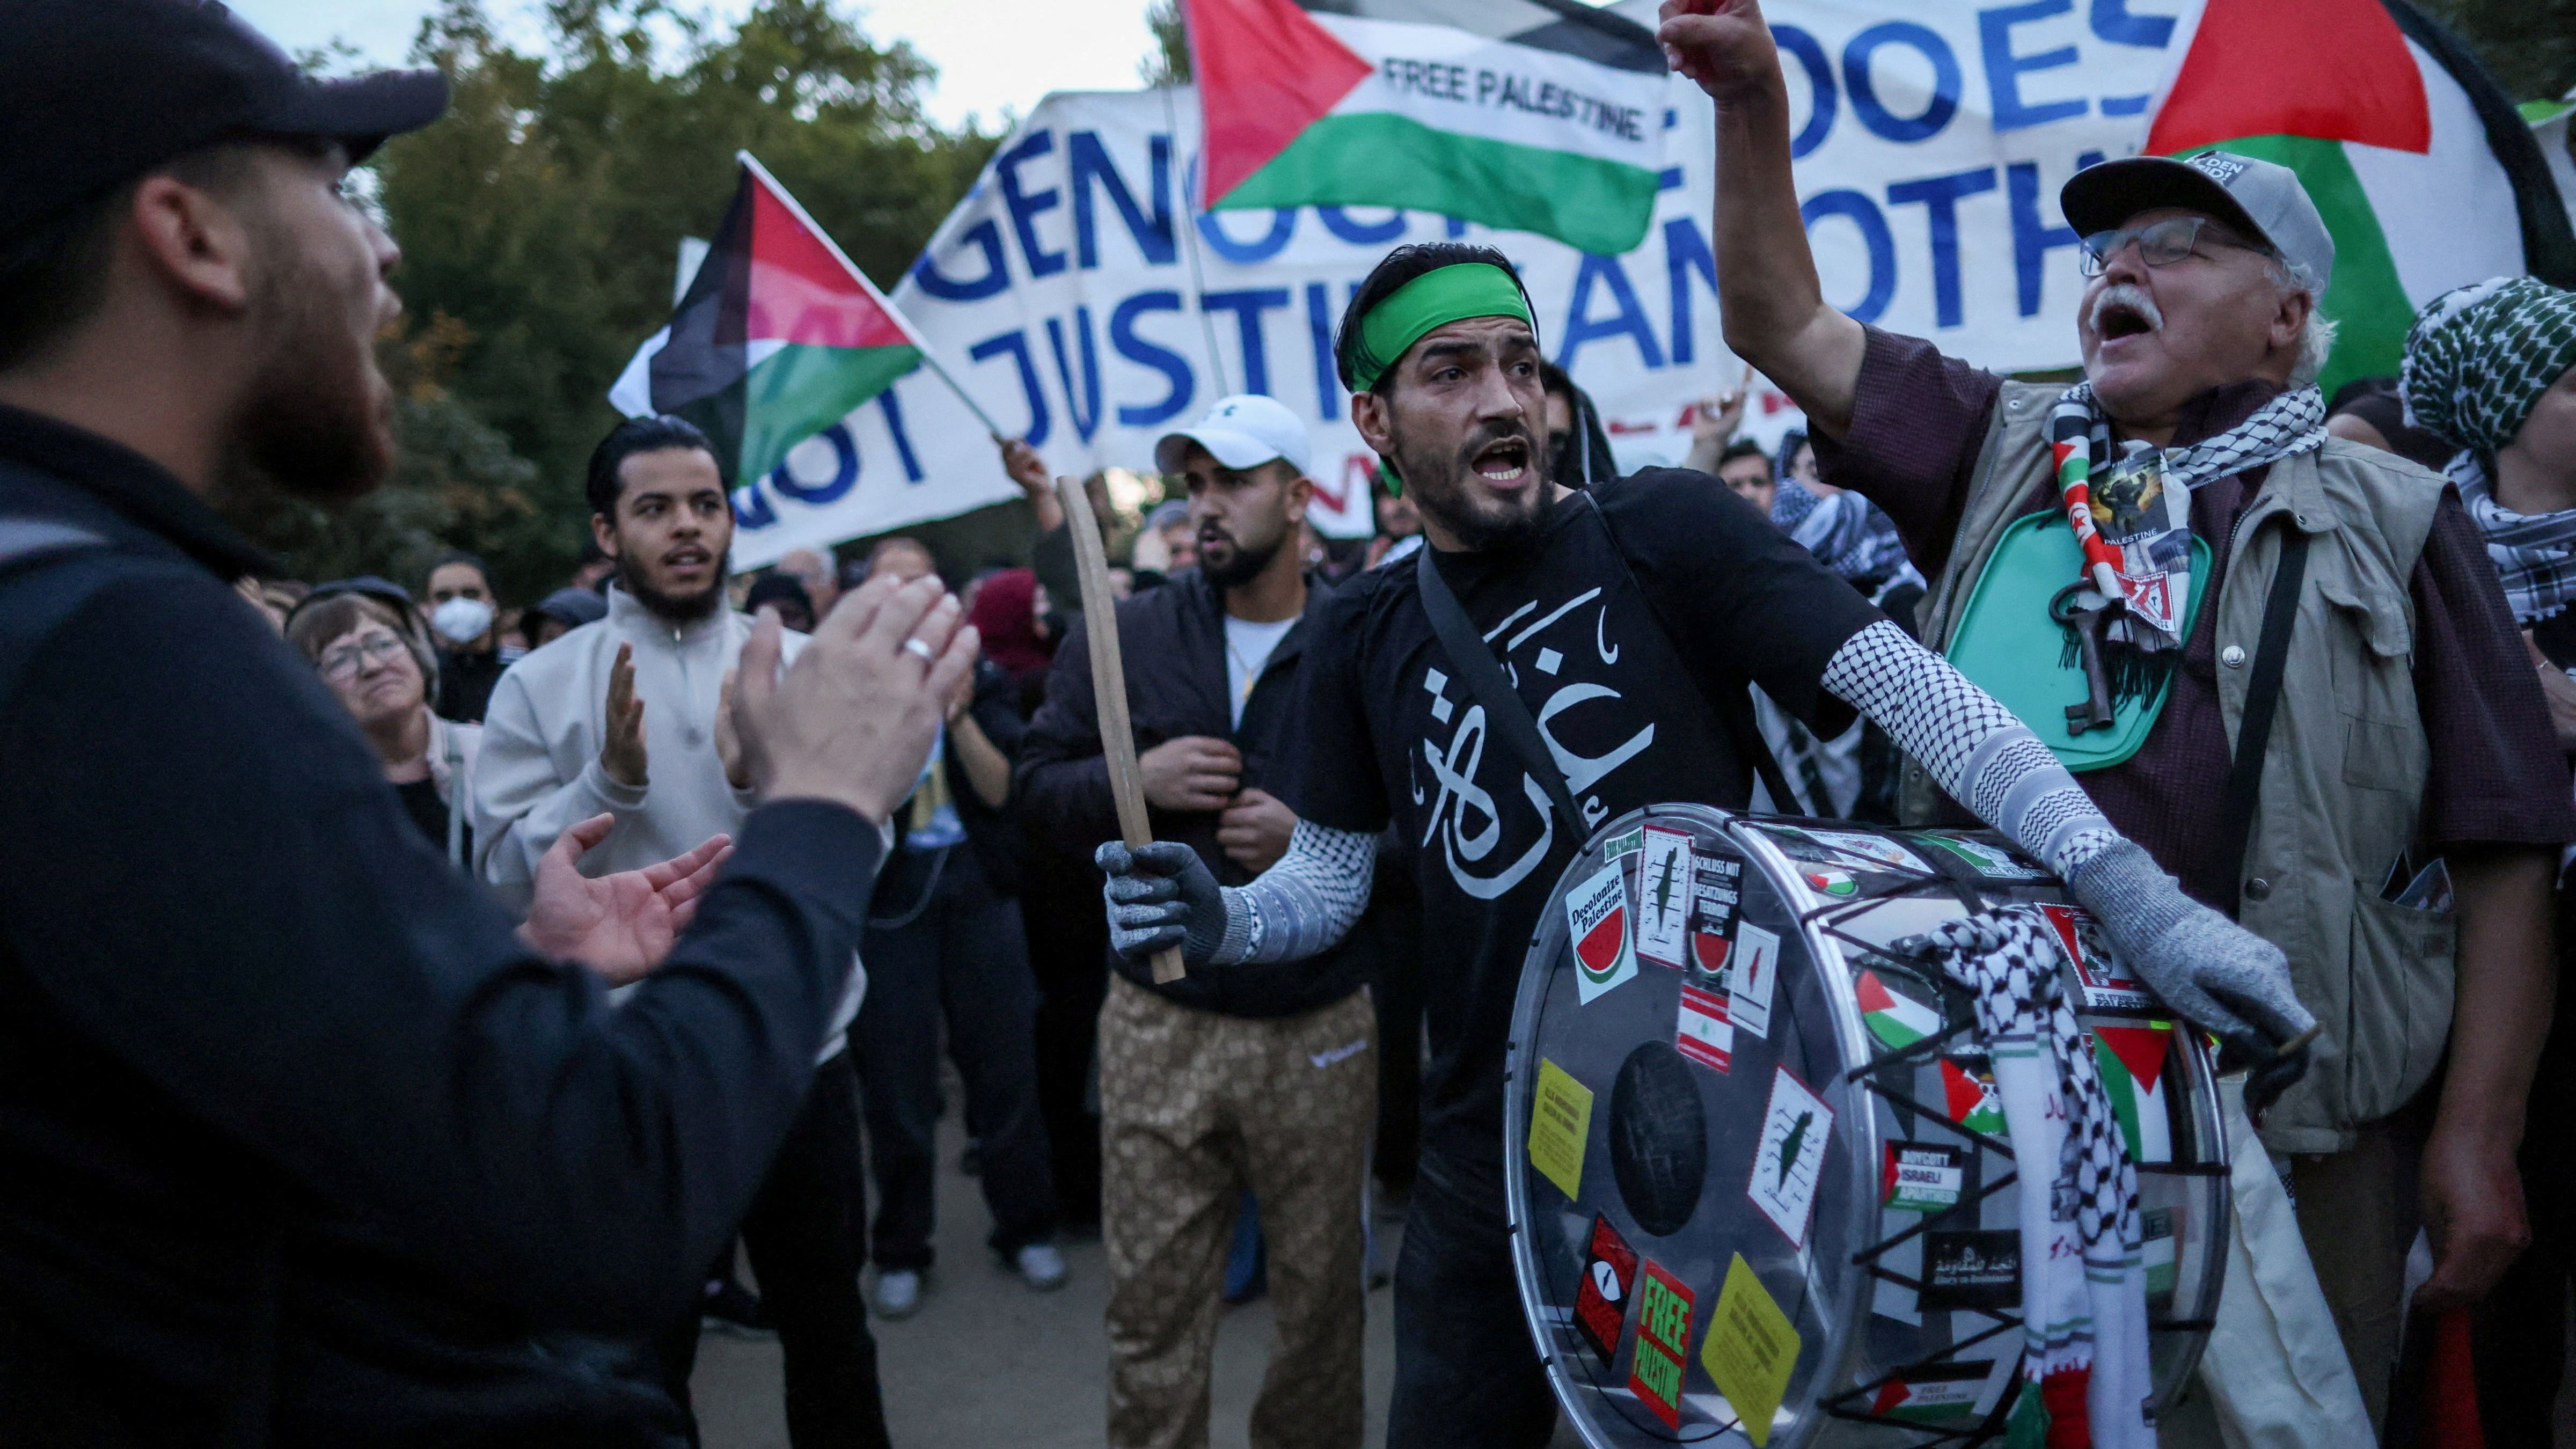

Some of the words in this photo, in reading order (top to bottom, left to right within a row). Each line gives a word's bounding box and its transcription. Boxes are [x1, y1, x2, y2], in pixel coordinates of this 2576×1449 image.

[1384, 56, 1468, 103] FREE
[1475, 68, 1647, 142] PALESTINE
[2206, 158, 2244, 173] DEN
[968, 264, 1522, 450] JUSTI
[1550, 150, 2106, 370] ANOTH
[2112, 455, 2135, 469] FREE
[2104, 528, 2158, 546] PALESTINE
[1695, 855, 1725, 874] SCHLUSS
[1725, 861, 1740, 877] MIT
[1572, 874, 1620, 927] Decolonize
[1581, 889, 1623, 934] Palestine
[1901, 1169, 1942, 1184] ISRAELI
[1641, 1272, 1690, 1357] FREE
[1633, 1334, 1682, 1410] PALESTINE
